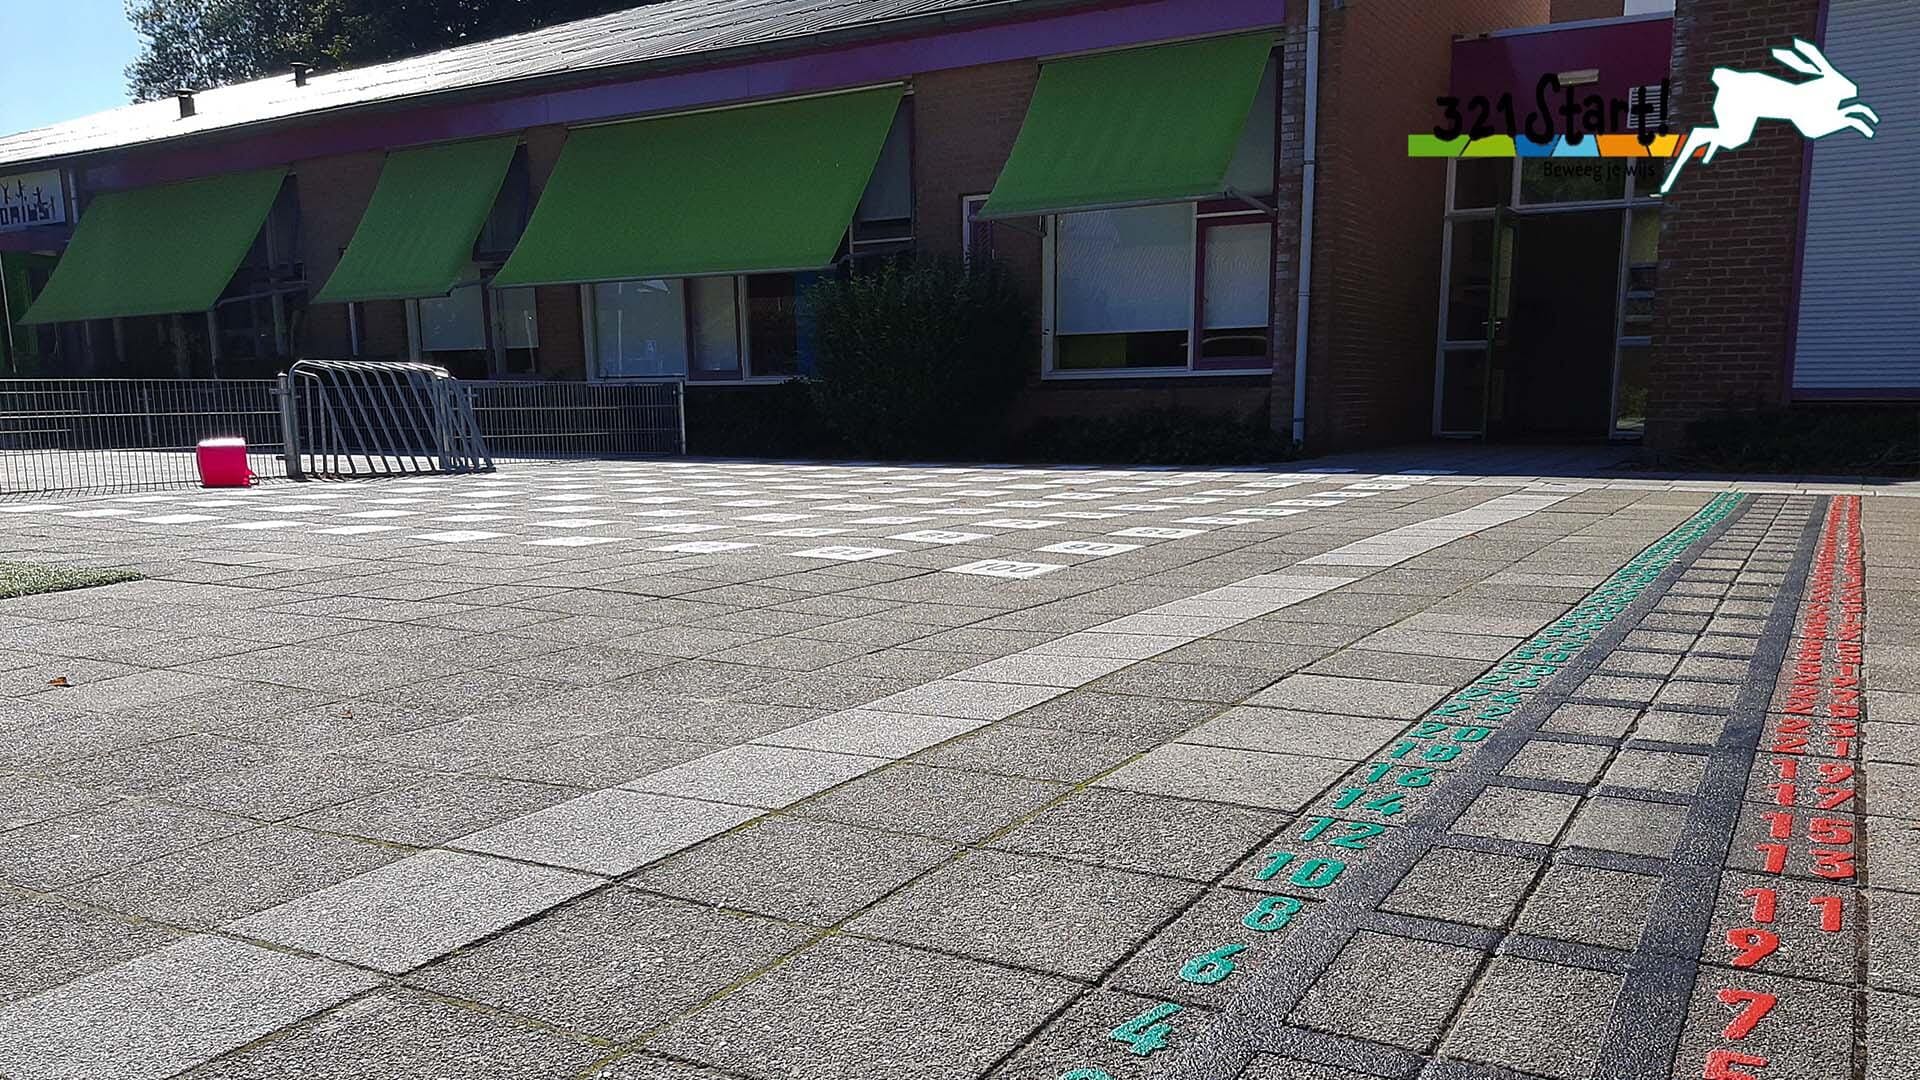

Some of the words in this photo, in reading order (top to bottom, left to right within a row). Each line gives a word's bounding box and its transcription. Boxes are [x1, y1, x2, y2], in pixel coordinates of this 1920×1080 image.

[1063, 543, 1114, 551] 90
[972, 562, 1041, 573] 100
[1407, 722, 1491, 743] 20
[1391, 742, 1463, 763] 18
[1364, 763, 1435, 788] 16
[1334, 788, 1405, 816] 14
[1302, 816, 1386, 849] 12
[1256, 851, 1347, 888] 10
[1242, 896, 1302, 932] 8
[1179, 944, 1248, 984] 6
[1726, 928, 1780, 968] 9
[1109, 1002, 1183, 1055] 4
[1718, 988, 1778, 1040] 7
